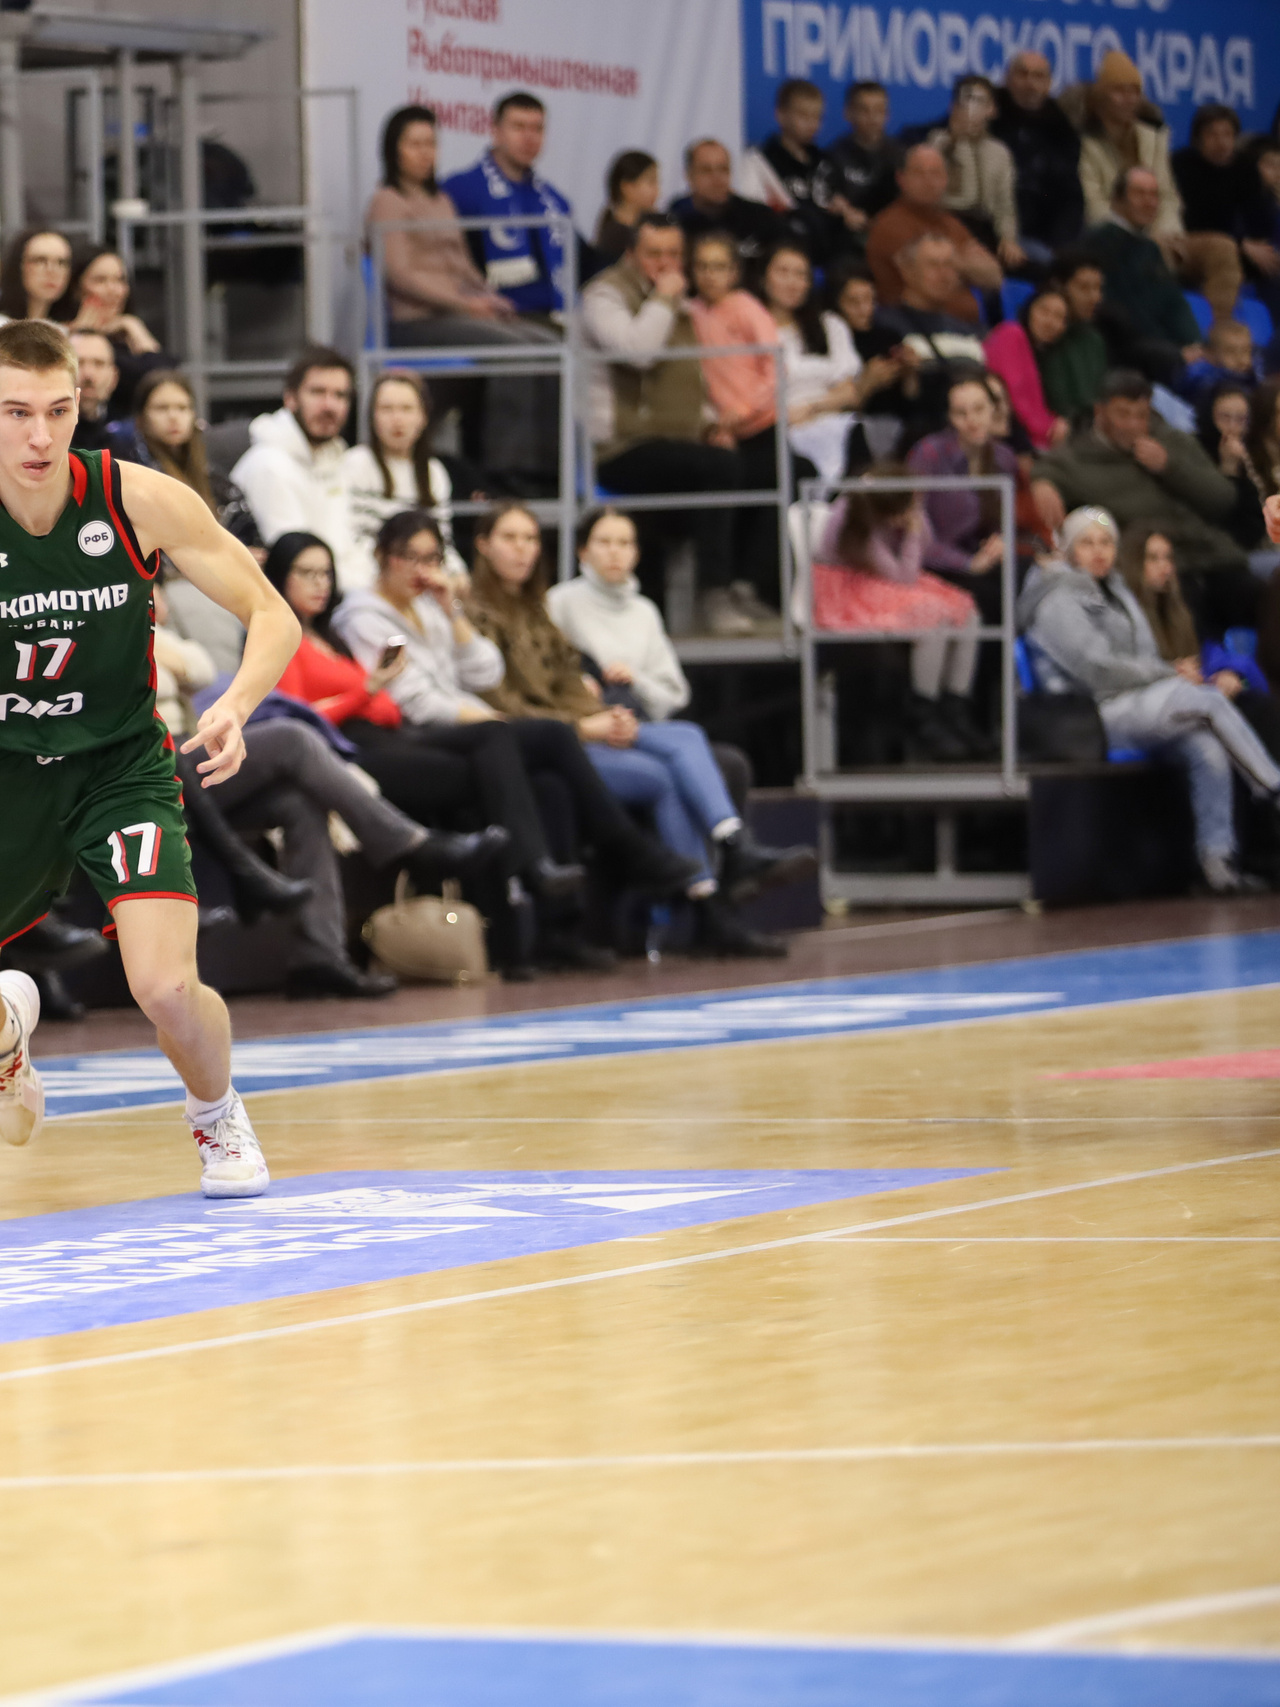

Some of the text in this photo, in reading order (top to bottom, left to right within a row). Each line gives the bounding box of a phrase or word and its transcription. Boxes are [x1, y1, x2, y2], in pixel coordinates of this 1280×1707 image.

[1136, 28, 1256, 108] КРАЯ
[84, 532, 109, 545] РФБ
[14, 637, 77, 681] 17
[107, 821, 162, 884] 17
